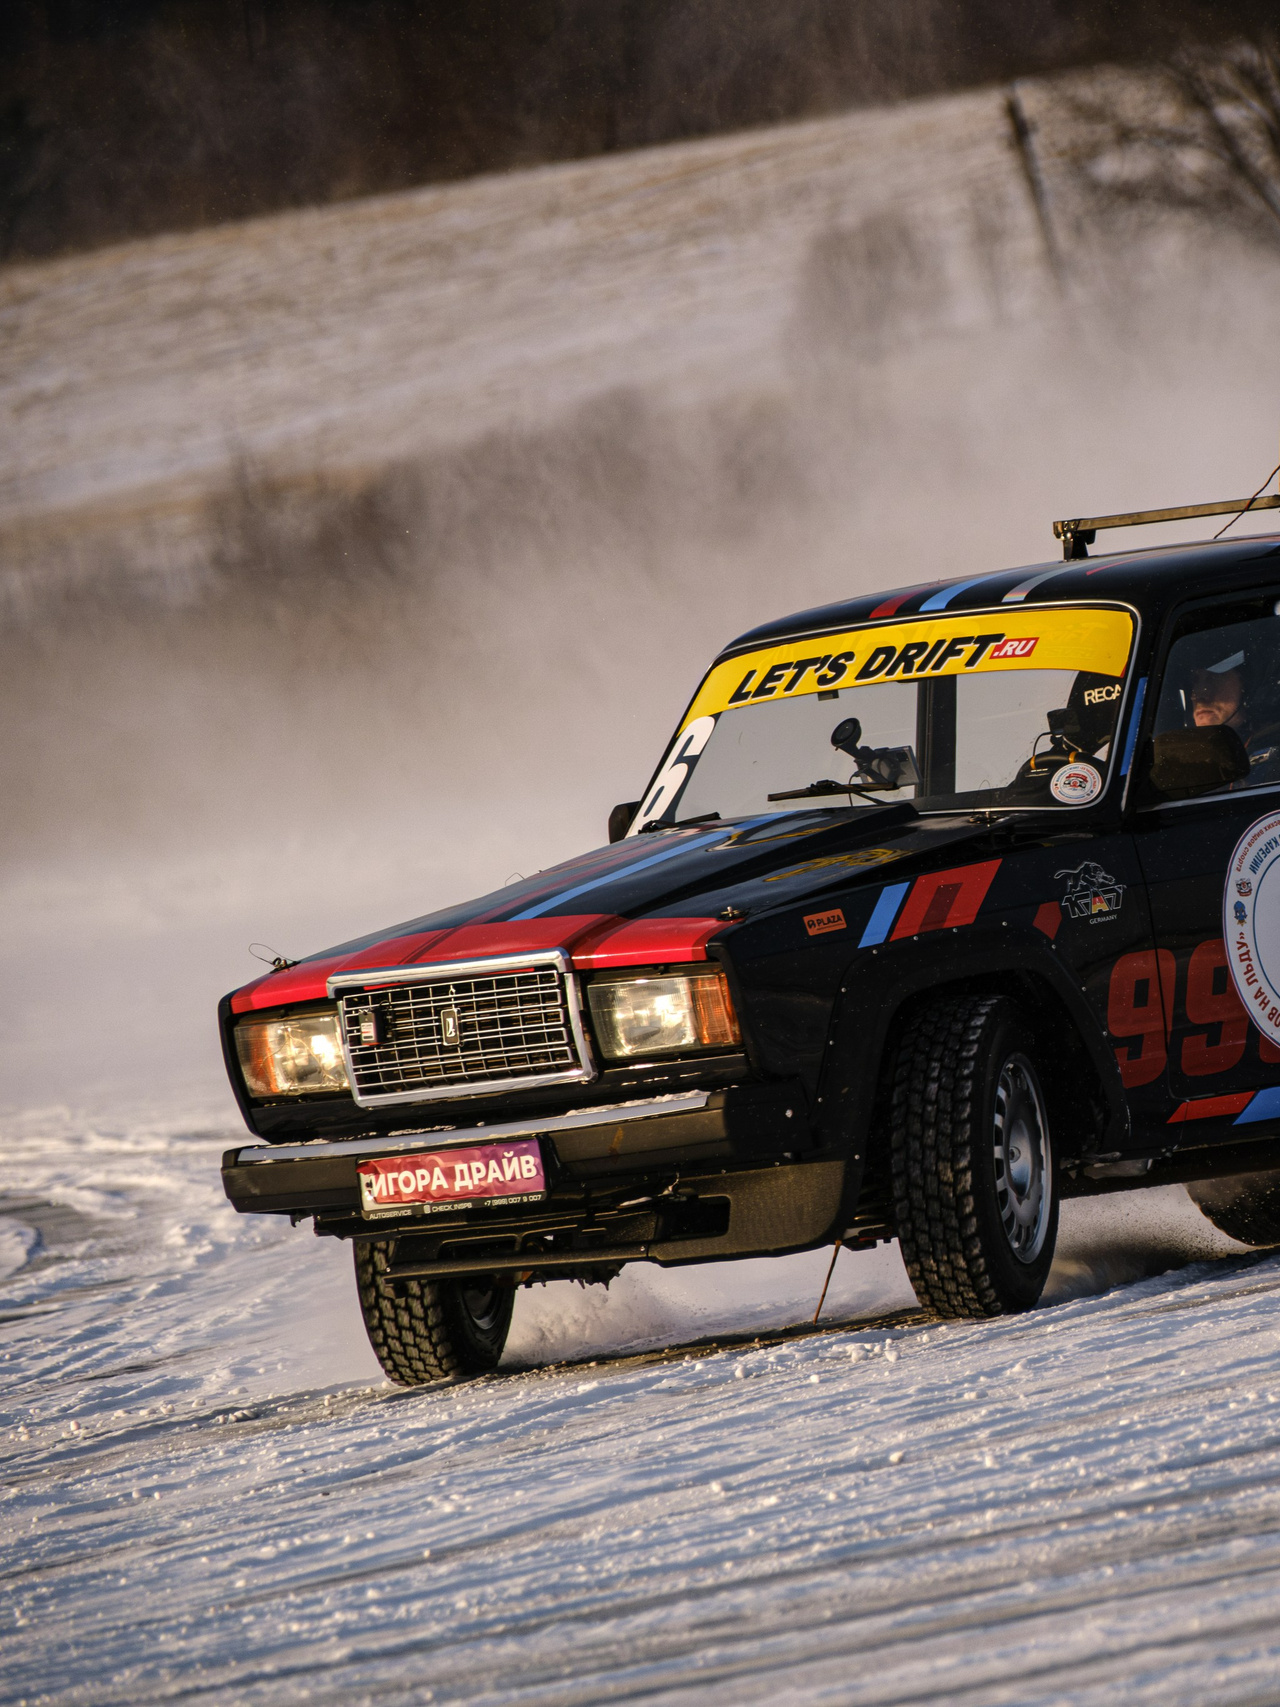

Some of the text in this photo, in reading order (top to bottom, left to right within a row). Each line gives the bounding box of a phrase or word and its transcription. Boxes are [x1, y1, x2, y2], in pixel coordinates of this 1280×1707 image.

[728, 650, 855, 705] LET'S
[624, 715, 716, 839] 6
[1248, 836, 1279, 875] КАРЕЛИИ
[1089, 914, 1118, 925] GERMANY
[1253, 986, 1270, 1011] НА
[372, 1151, 538, 1198] ИГОРА ДРАЙВ
[369, 1209, 412, 1220] AUTOSERVICE
